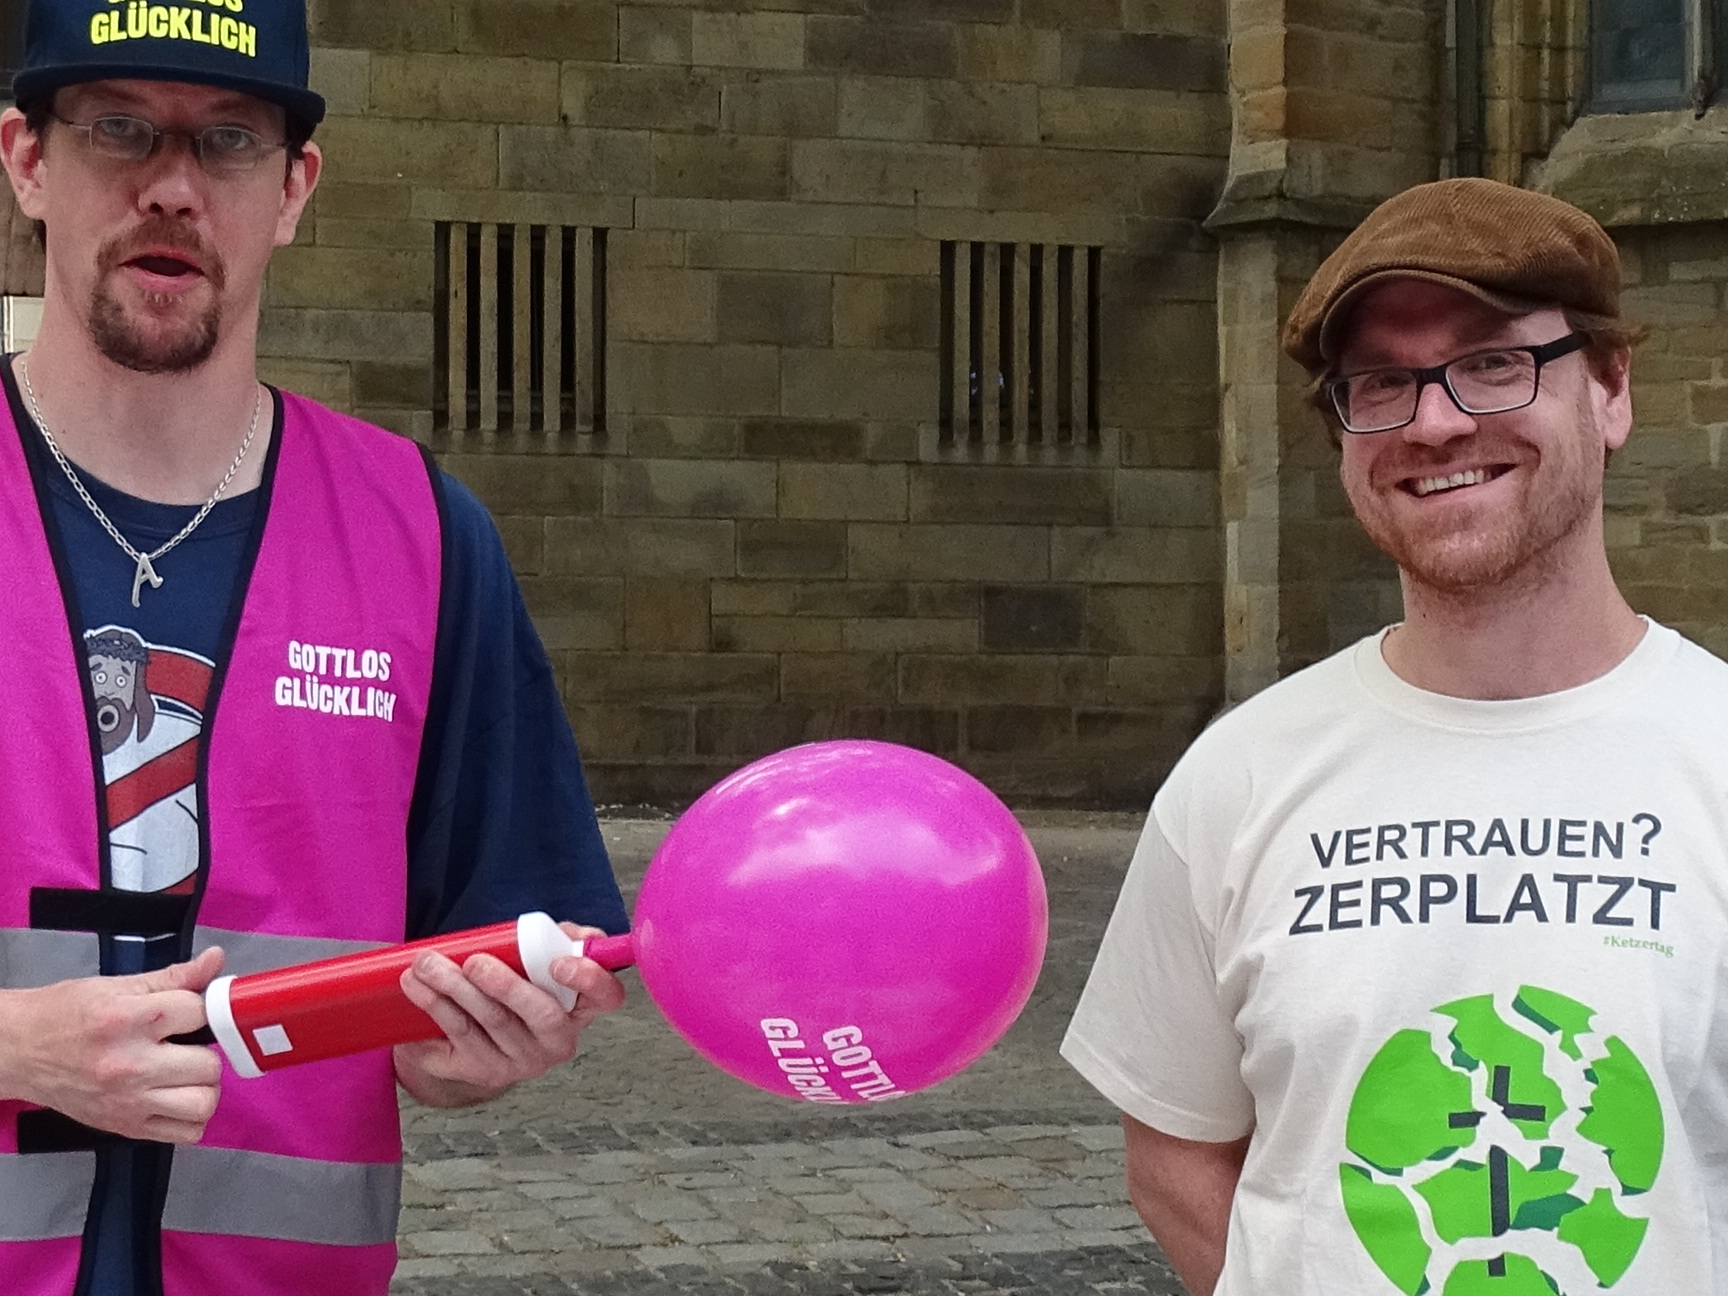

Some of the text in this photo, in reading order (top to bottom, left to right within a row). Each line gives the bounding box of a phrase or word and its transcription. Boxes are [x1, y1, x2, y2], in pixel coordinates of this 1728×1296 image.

[91, 1, 256, 57] GLÜCKLICH
[289, 640, 392, 681] GOTTLOS
[275, 674, 397, 722] GLÜCKLICH
[1310, 812, 1663, 869] VERTRAUEN?
[1288, 873, 1677, 937] ZERPLATZT
